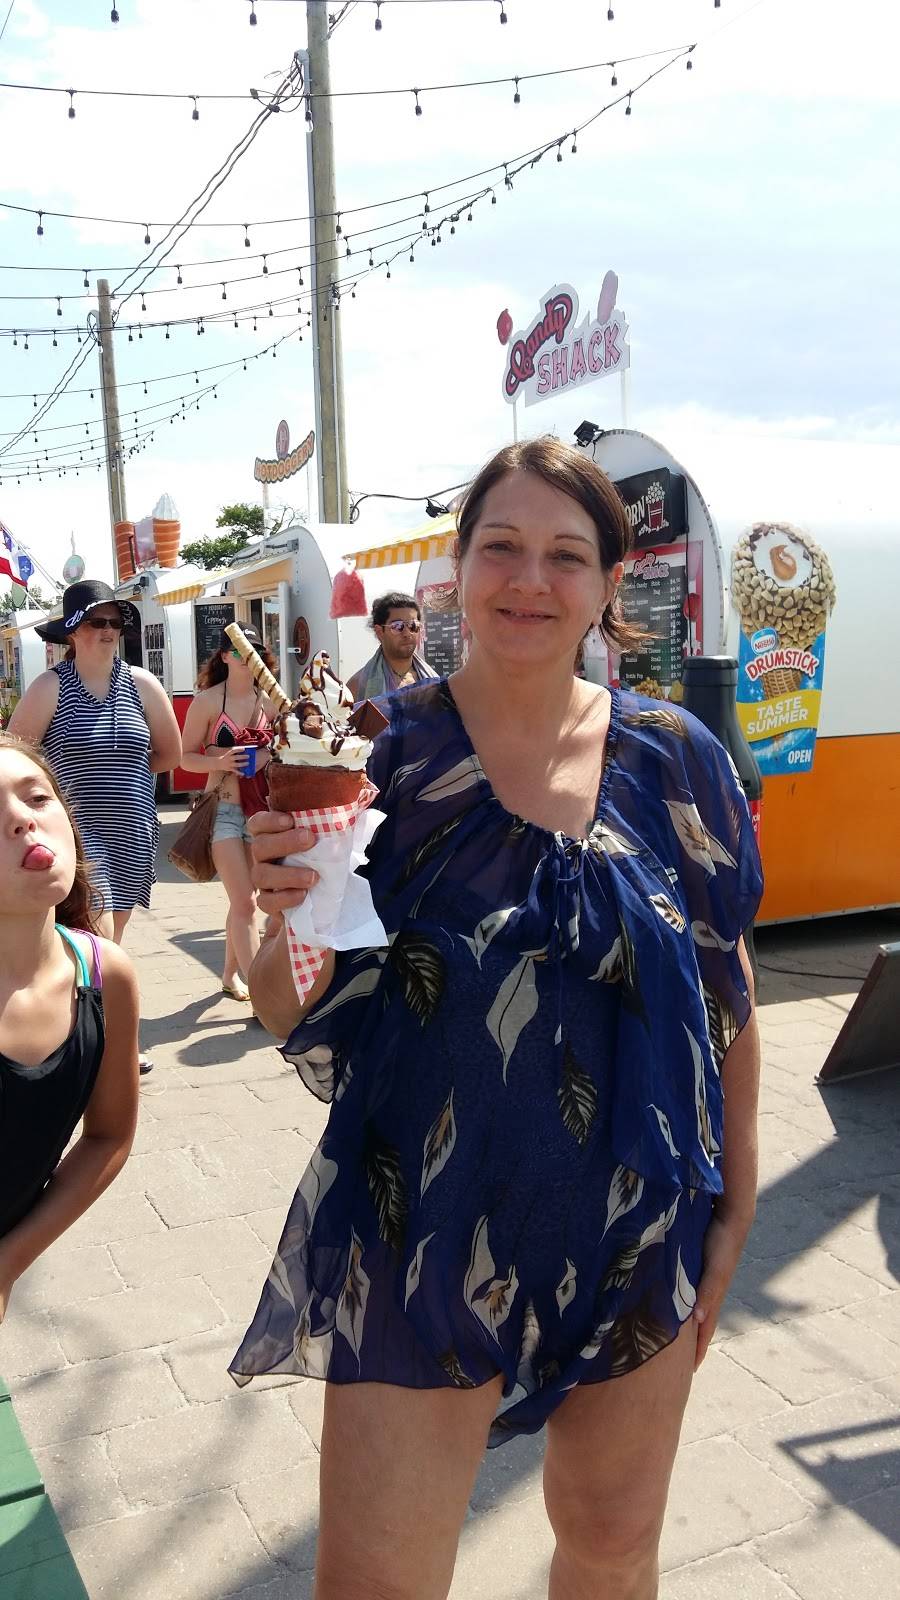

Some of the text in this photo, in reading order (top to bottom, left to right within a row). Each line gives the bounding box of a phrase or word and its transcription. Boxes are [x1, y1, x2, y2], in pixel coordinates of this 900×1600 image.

[506, 293, 573, 396] Candy
[537, 320, 622, 394] SHACK
[746, 650, 817, 679] DRUMSTICK
[747, 708, 809, 735] SUMMER
[757, 696, 802, 720] TASTE
[787, 749, 812, 765] OPEN
